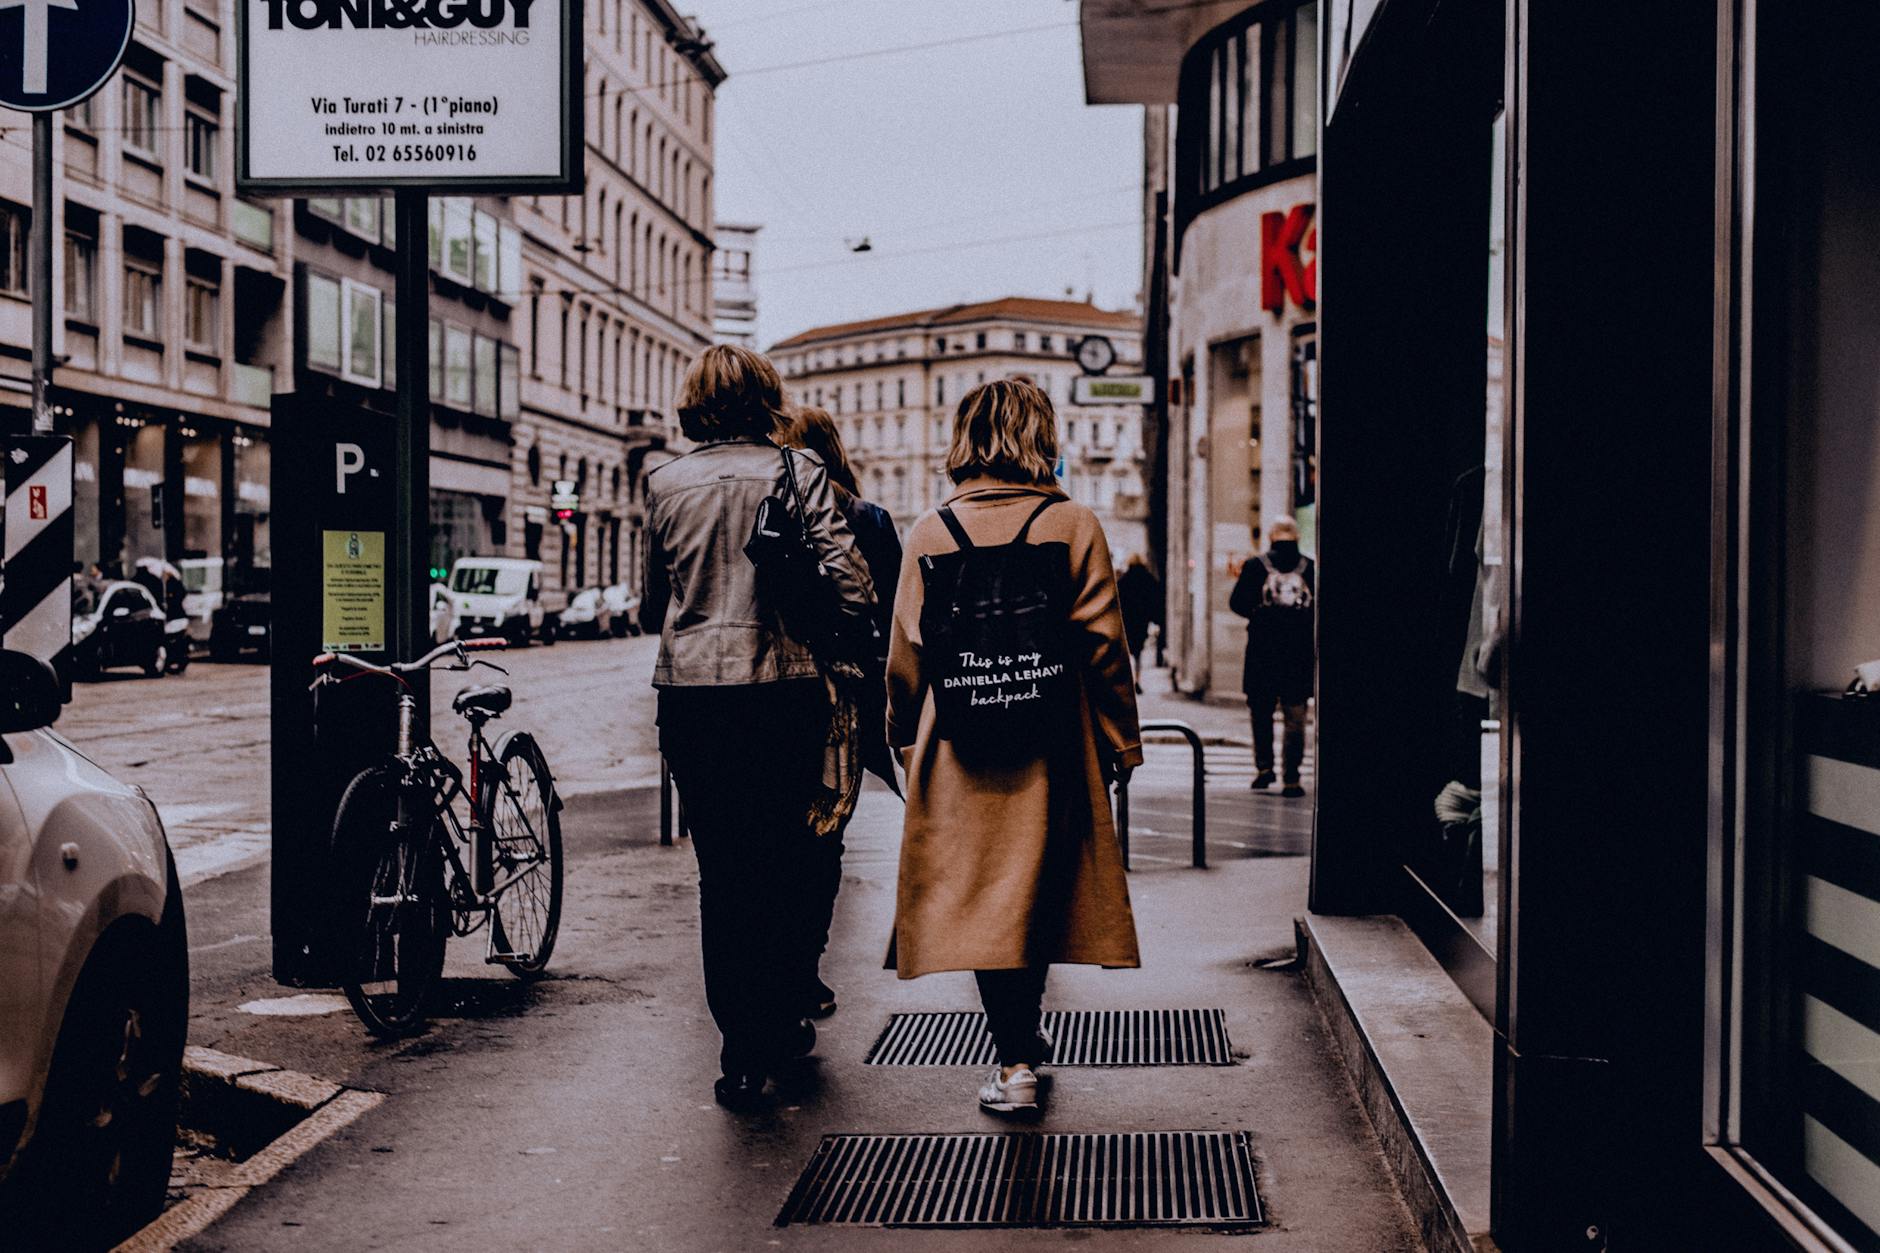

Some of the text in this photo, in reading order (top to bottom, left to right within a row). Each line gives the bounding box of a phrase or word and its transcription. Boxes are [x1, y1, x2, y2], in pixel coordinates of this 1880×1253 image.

[259, 0, 535, 30] TONI&GUY
[413, 30, 531, 46] HAIRDRESSING
[311, 97, 337, 114] Via
[343, 97, 388, 114] Turati
[395, 97, 404, 113] 7
[325, 122, 484, 136] indietro 10 mt. a sinistra
[333, 145, 477, 162] Tel. 02 65560916
[336, 443, 365, 494] P
[959, 652, 1041, 669] This is my
[944, 673, 1011, 688] DANIELLA
[970, 683, 1041, 709] backpack
